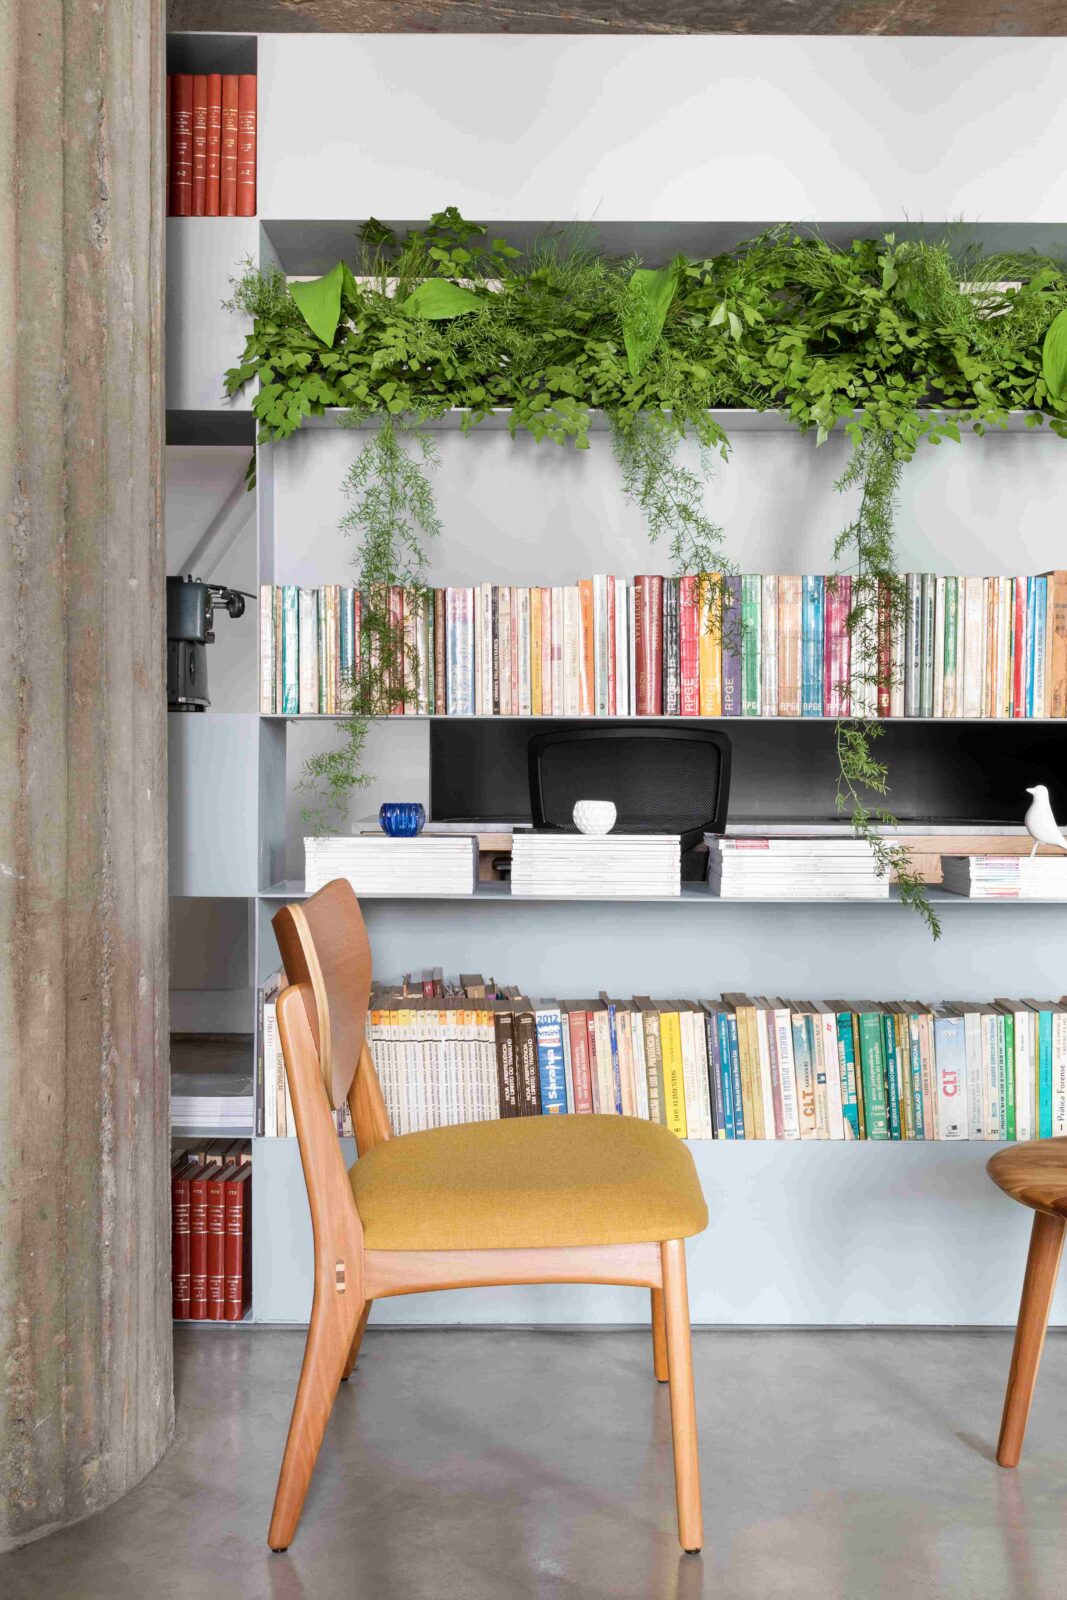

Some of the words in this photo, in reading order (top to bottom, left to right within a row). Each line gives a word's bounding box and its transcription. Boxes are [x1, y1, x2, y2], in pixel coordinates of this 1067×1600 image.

[684, 678, 694, 712] RPGE
[725, 678, 734, 710] RPGE
[803, 702, 822, 711] RPGE
[537, 1015, 558, 1024] 2012
[509, 1067, 513, 1075] DO
[530, 1067, 534, 1075] DO
[546, 1049, 557, 1099] Saraiva
[943, 1069, 957, 1097] CLT
[1057, 1064, 1065, 1094] Forense
[802, 1090, 814, 1117] CLT
[1056, 1096, 1065, 1121] Prática
